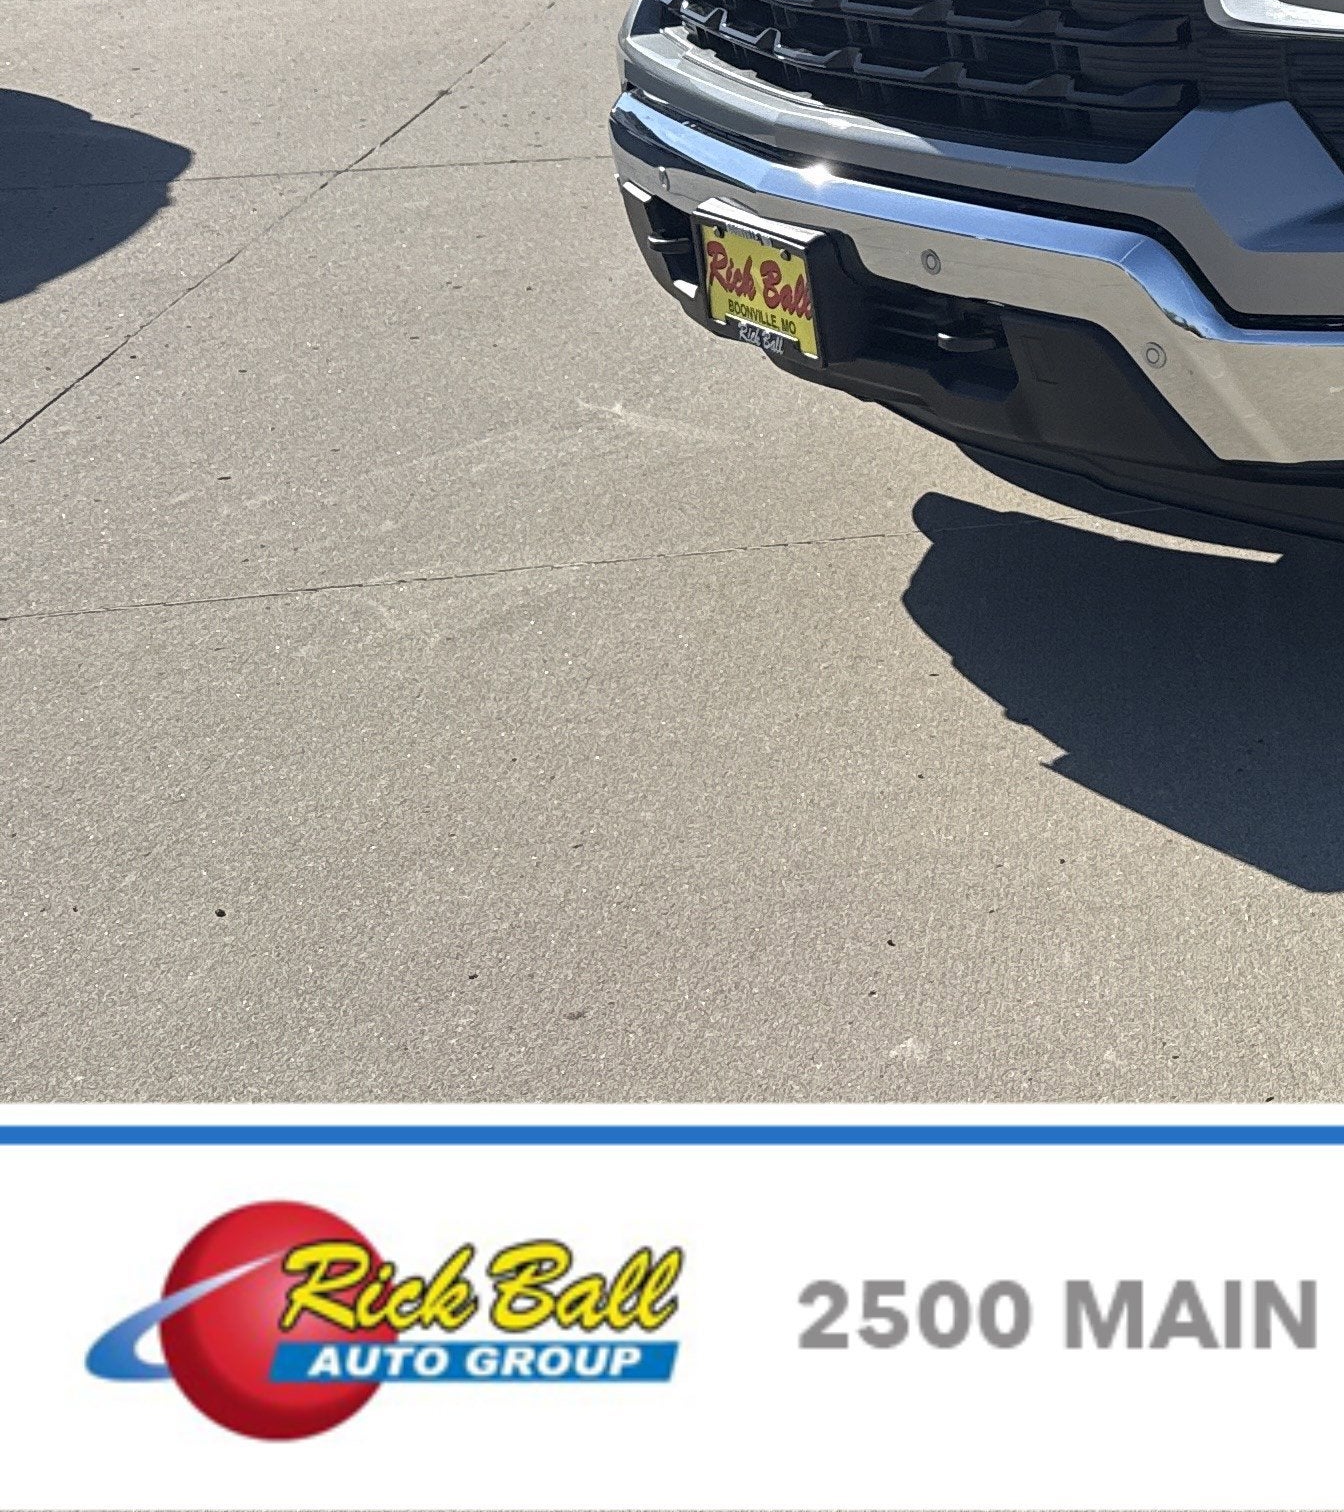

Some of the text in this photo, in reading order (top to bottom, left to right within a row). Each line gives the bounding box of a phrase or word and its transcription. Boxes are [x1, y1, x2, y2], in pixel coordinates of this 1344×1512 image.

[706, 240, 812, 320] Rick Ball
[781, 317, 797, 335] MO
